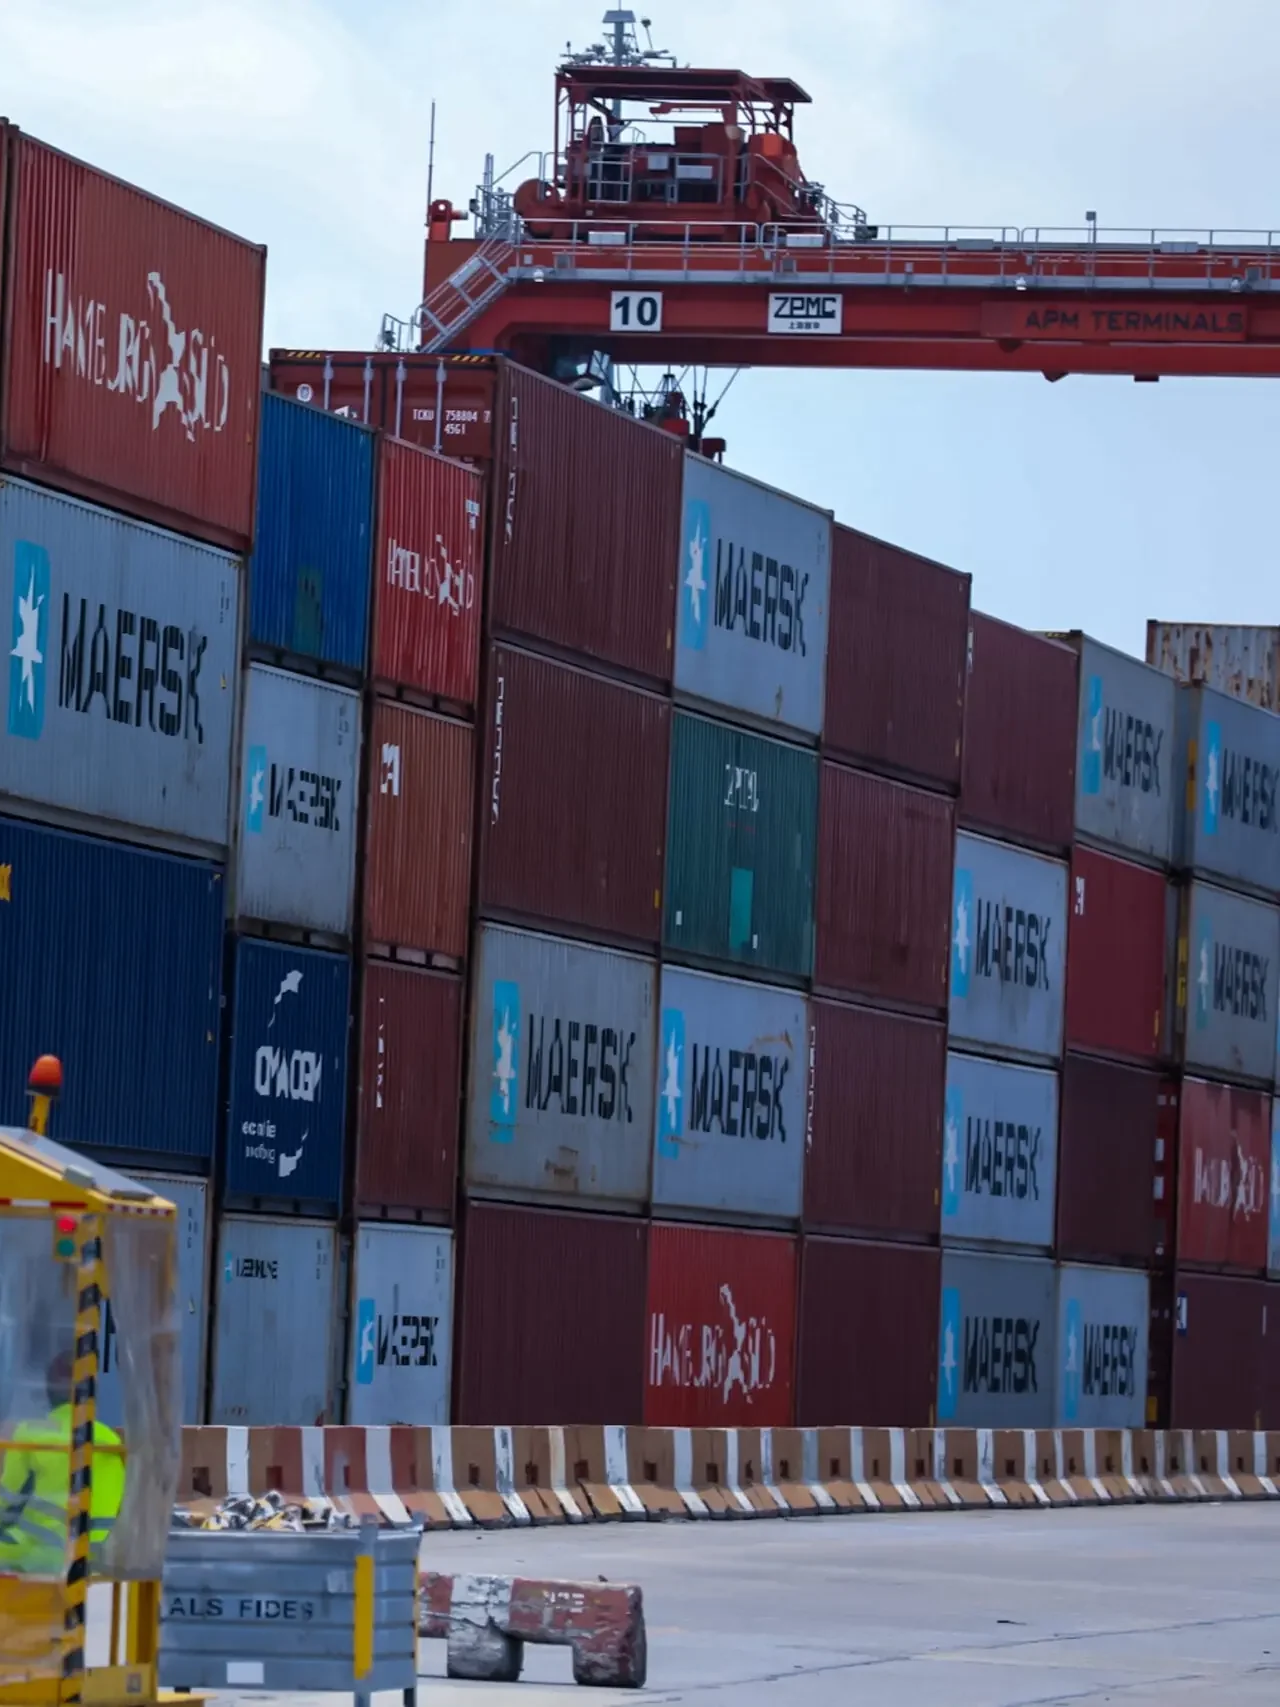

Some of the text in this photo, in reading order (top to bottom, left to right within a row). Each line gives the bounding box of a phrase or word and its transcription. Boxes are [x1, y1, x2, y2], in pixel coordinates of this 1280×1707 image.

[615, 296, 658, 326] 10
[774, 296, 836, 319] ZPMC
[1025, 309, 1244, 333] APM TERMINALS
[714, 537, 810, 658] MAERSK
[58, 592, 208, 744] MAERSK
[975, 898, 1050, 991] MAERSK
[525, 1013, 637, 1124] MAERSK
[689, 1042, 790, 1144] MAERSK
[964, 1115, 1042, 1200] MAERSK
[963, 1315, 1041, 1394] MAERSK
[1083, 1323, 1139, 1398] MAERSK
[169, 1597, 313, 1621] ALS FIDES
